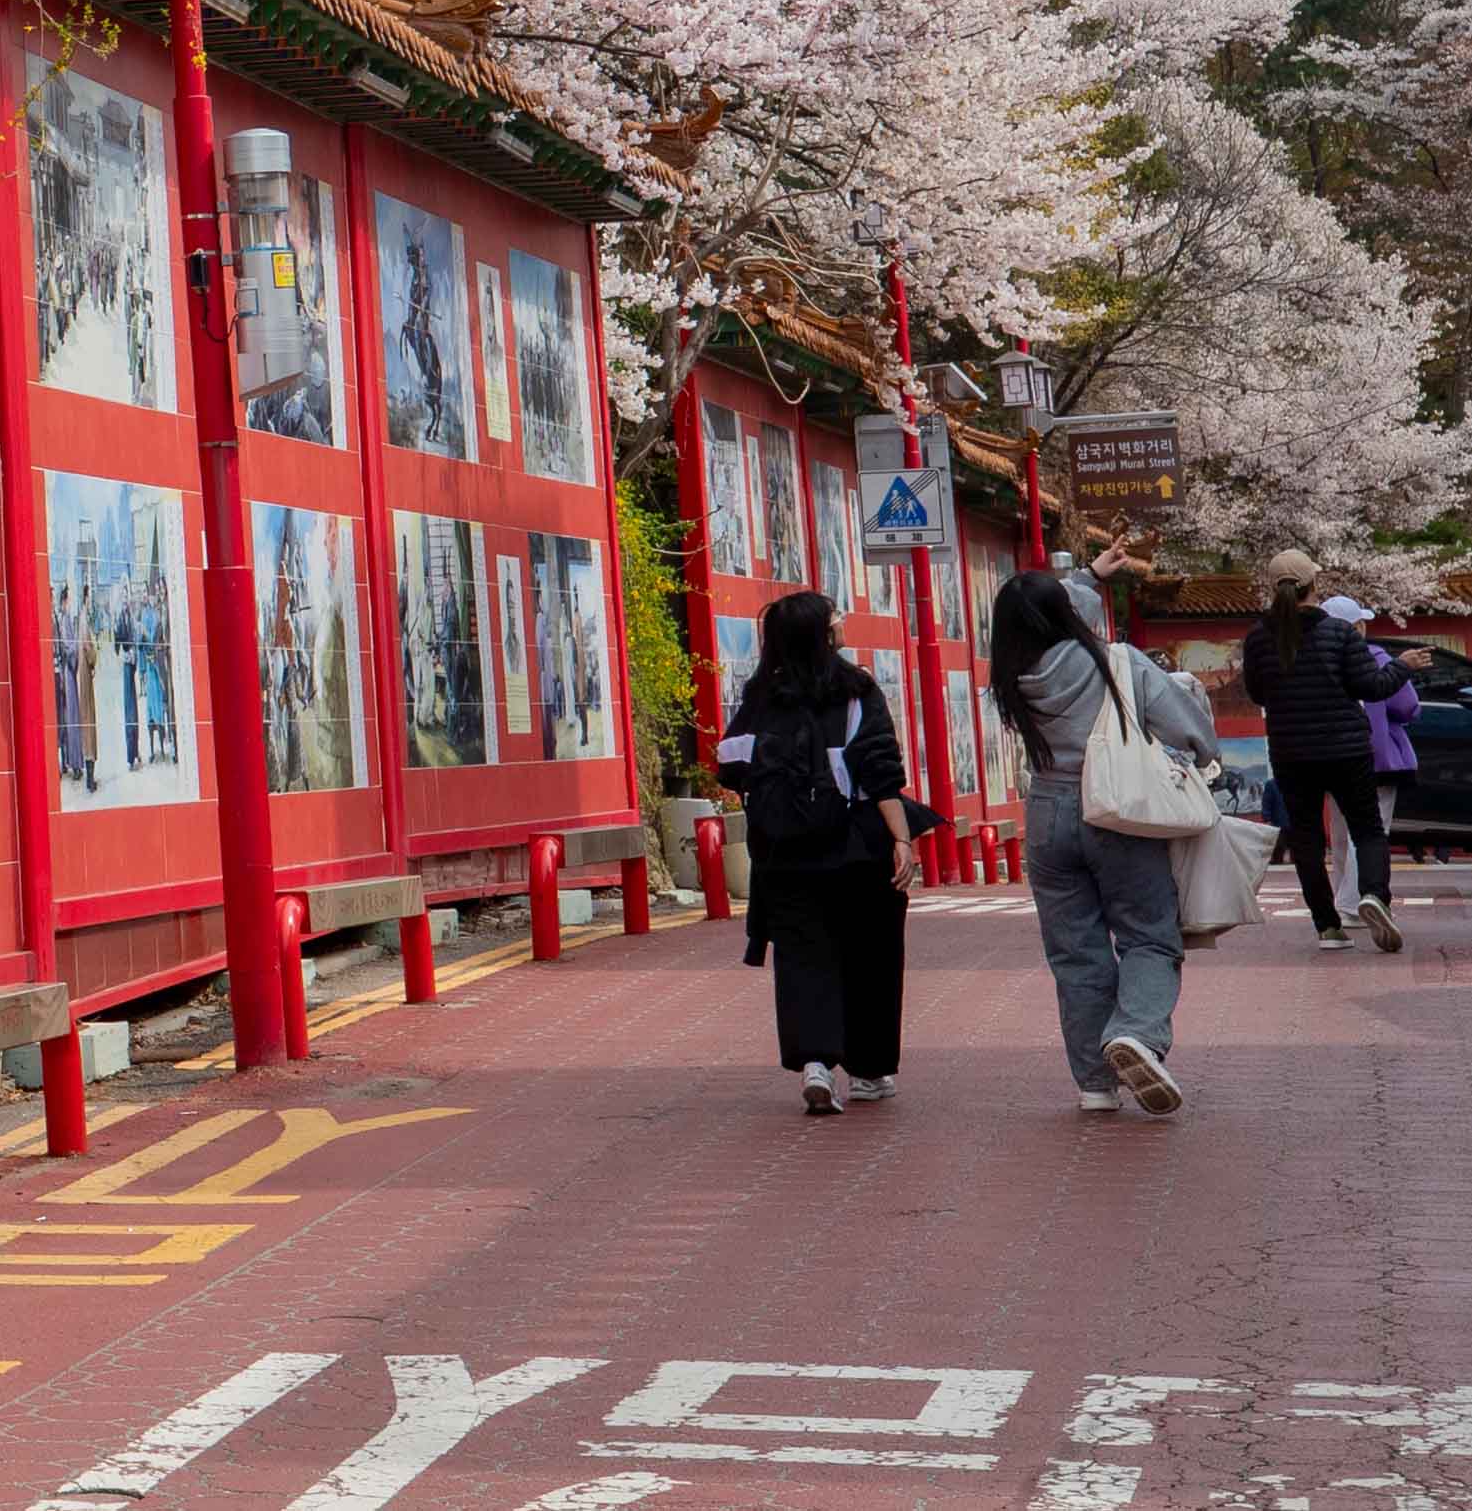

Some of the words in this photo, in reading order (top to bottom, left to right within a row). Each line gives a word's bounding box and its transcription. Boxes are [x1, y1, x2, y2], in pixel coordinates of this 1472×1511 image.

[1075, 441, 1116, 460] 삼국지
[1118, 438, 1173, 457] 벽화거리
[1077, 460, 1117, 473] Samgukji
[1120, 459, 1145, 469] Mural
[1149, 457, 1175, 468] Street
